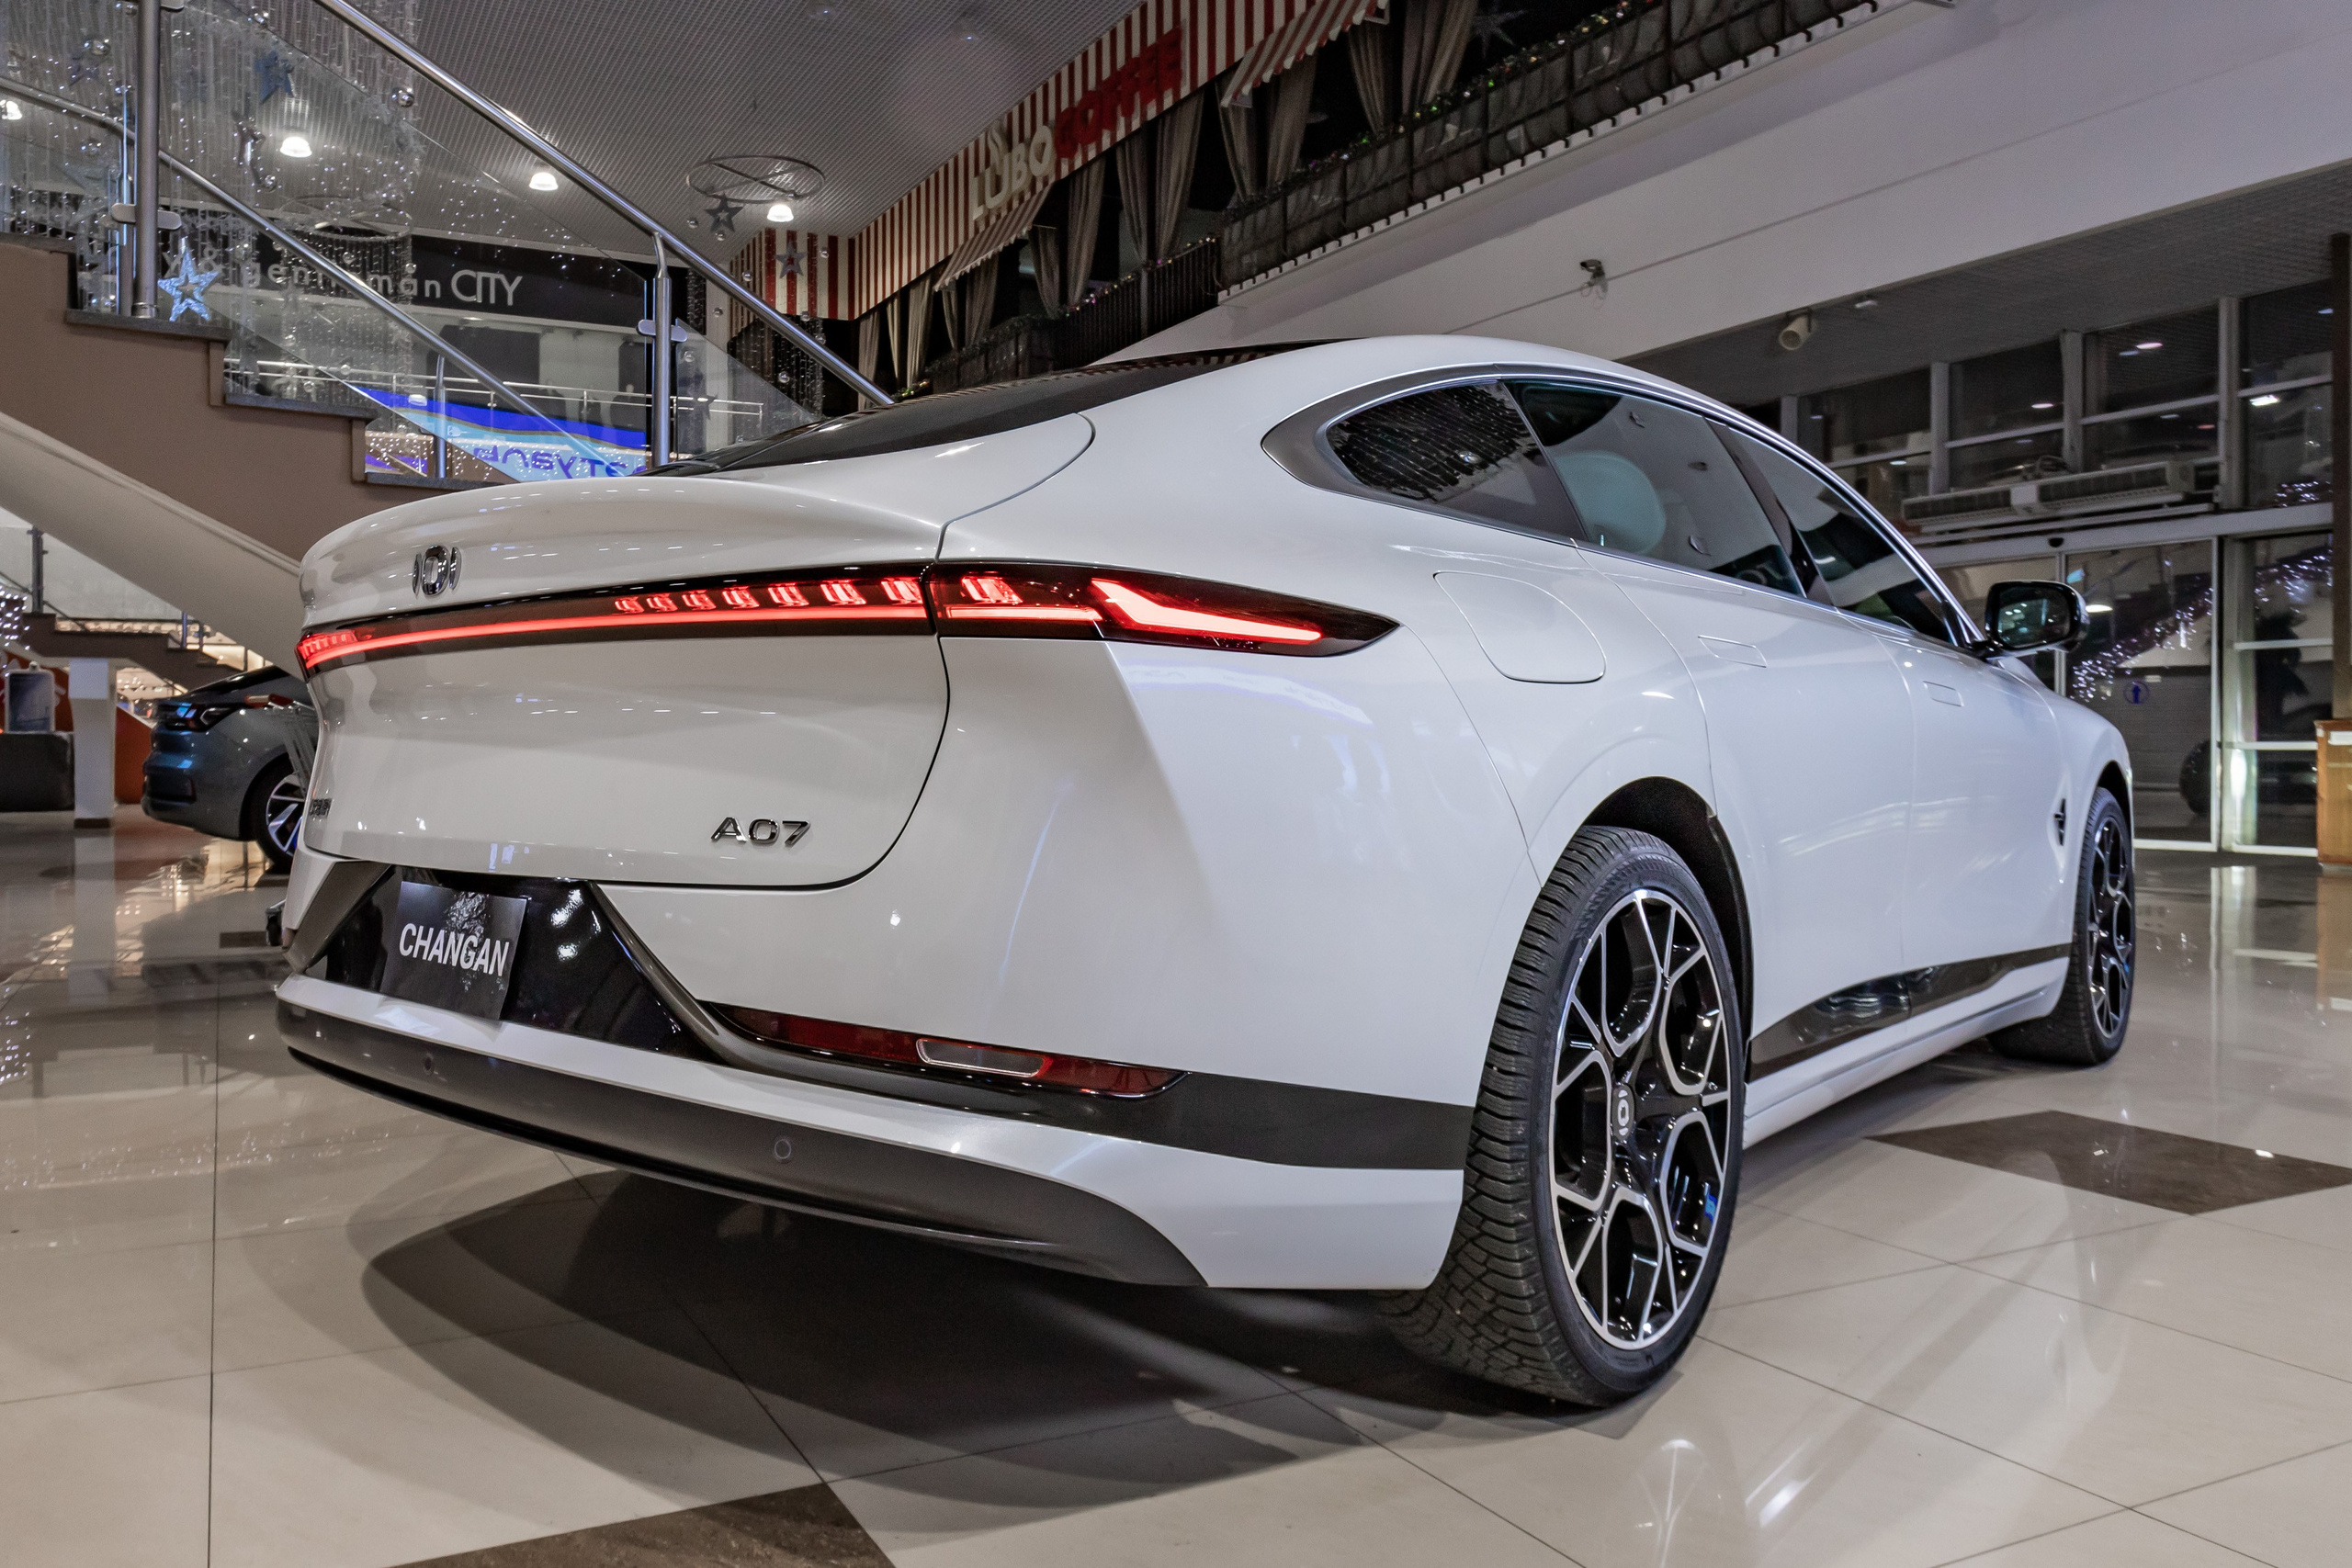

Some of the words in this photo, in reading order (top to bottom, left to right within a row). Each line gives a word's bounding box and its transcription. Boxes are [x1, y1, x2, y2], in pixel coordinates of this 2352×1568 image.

[242, 260, 442, 299] genman
[450, 268, 523, 307] CITY
[399, 922, 510, 976] CHANGAN
